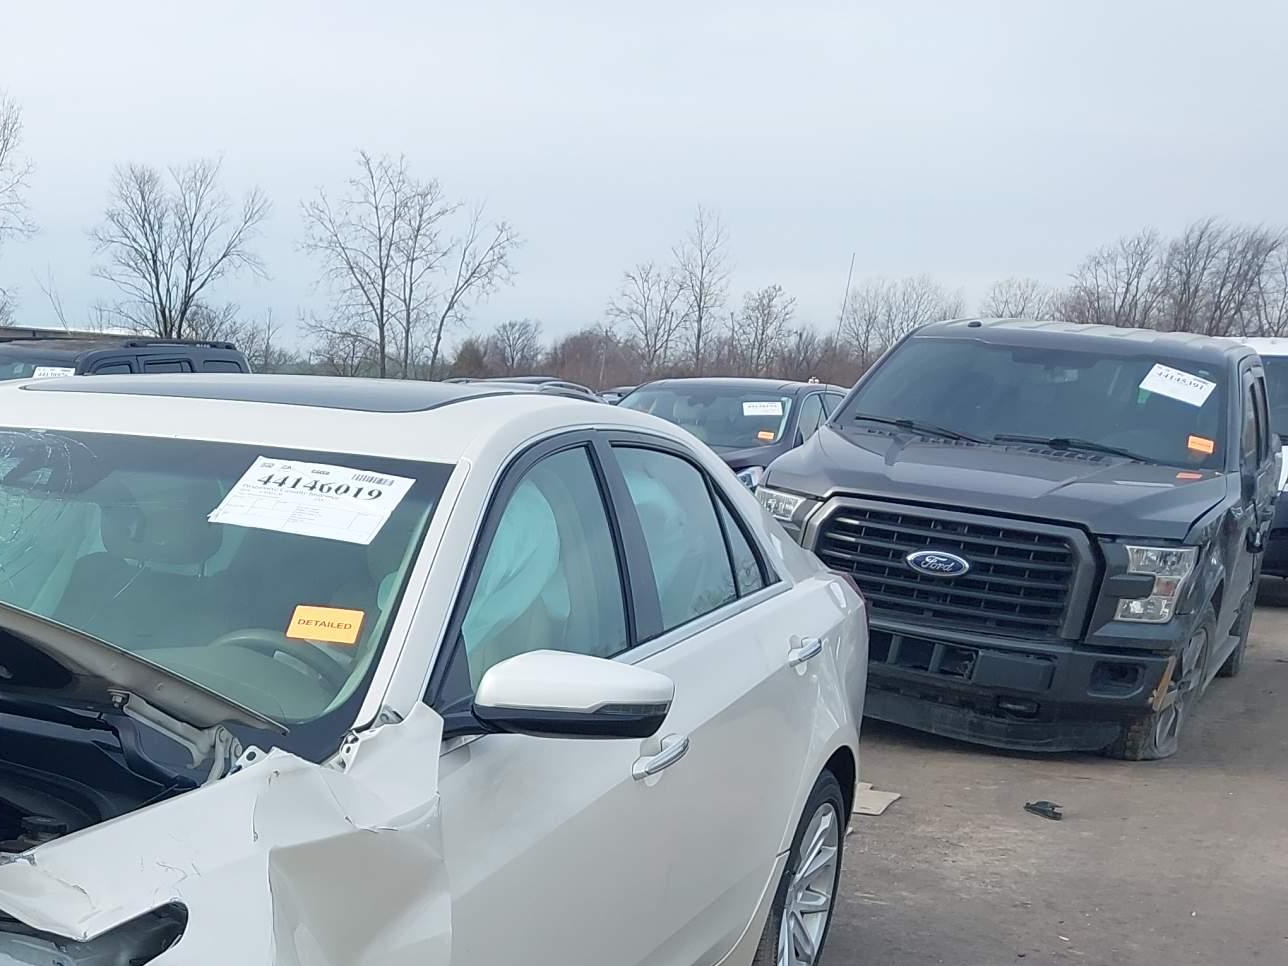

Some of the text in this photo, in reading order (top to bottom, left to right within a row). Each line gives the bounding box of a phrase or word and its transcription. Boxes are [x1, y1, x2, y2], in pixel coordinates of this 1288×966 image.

[257, 473, 383, 501] 44146019
[920, 555, 955, 572] Ford
[297, 618, 353, 630] DETAILED
